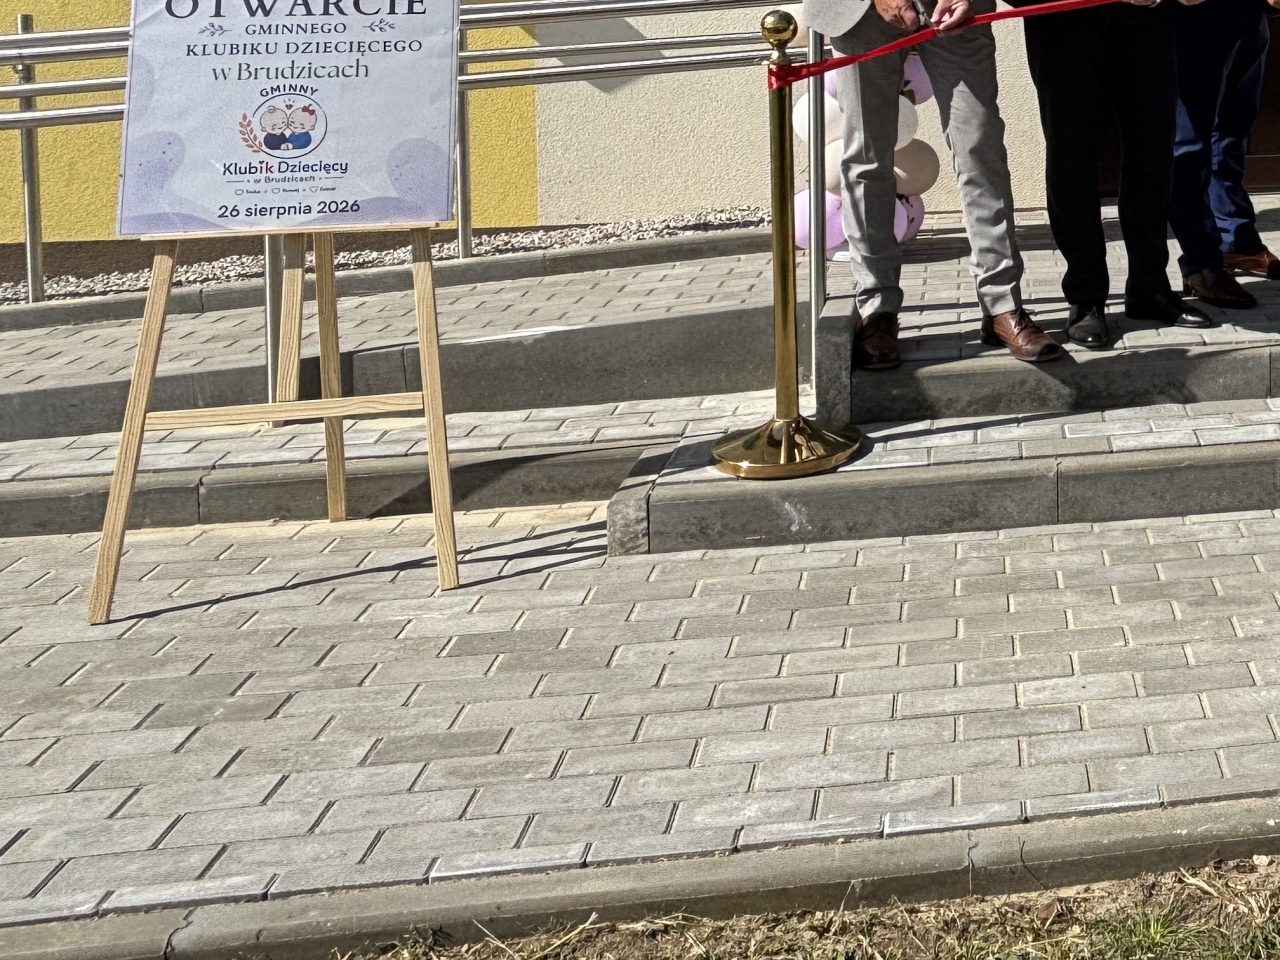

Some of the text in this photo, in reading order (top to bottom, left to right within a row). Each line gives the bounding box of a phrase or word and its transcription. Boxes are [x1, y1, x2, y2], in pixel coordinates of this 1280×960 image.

[245, 22, 347, 35] GMINNEGO
[185, 40, 422, 57] KLUBIKU DZIECIĘCEGO
[212, 58, 369, 81] w Brudzicach
[259, 83, 319, 97] GMINNY
[223, 160, 348, 176] Klubik Dziecięcy
[218, 200, 360, 219] 26 sierpnia 2026
